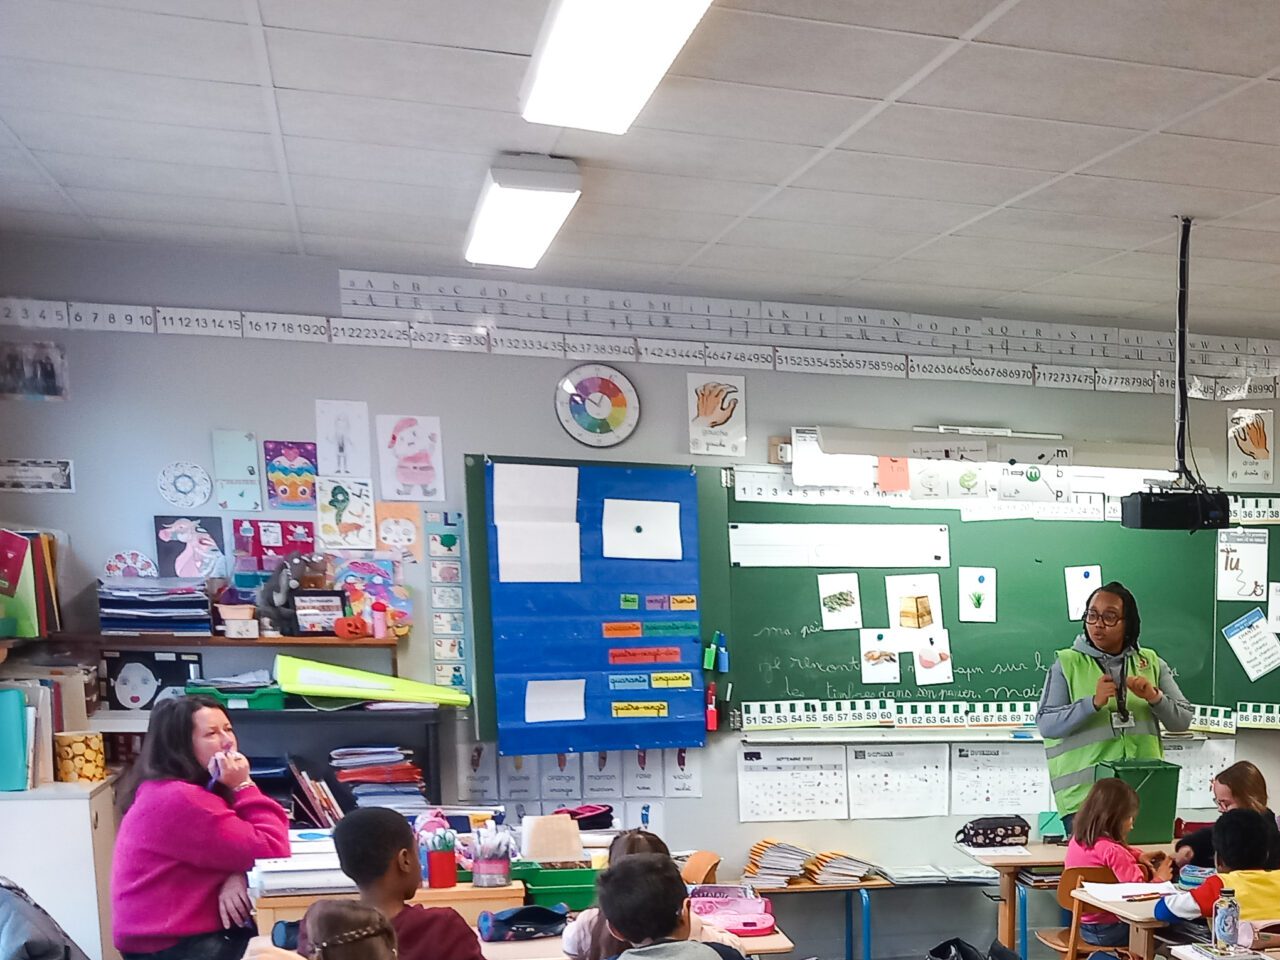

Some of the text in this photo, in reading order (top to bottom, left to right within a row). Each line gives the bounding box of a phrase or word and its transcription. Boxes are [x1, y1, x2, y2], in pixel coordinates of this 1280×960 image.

[74, 312, 326, 335] 6 7 8 9 10 11 12 13 14 15 16 17 18 19 20
[1056, 449, 1067, 458] m
[1056, 489, 1063, 501] p
[1242, 510, 1253, 519] 36
[1255, 510, 1266, 518] 37
[1269, 510, 1279, 518] 38
[791, 715, 802, 723] 54
[806, 714, 817, 722] 55
[837, 713, 848, 721] 57
[866, 712, 877, 720] 59
[997, 714, 1008, 722] 68
[1265, 715, 1276, 723] 88
[1200, 718, 1208, 726] 83
[1210, 719, 1220, 727] 84
[547, 774, 575, 784] orange
